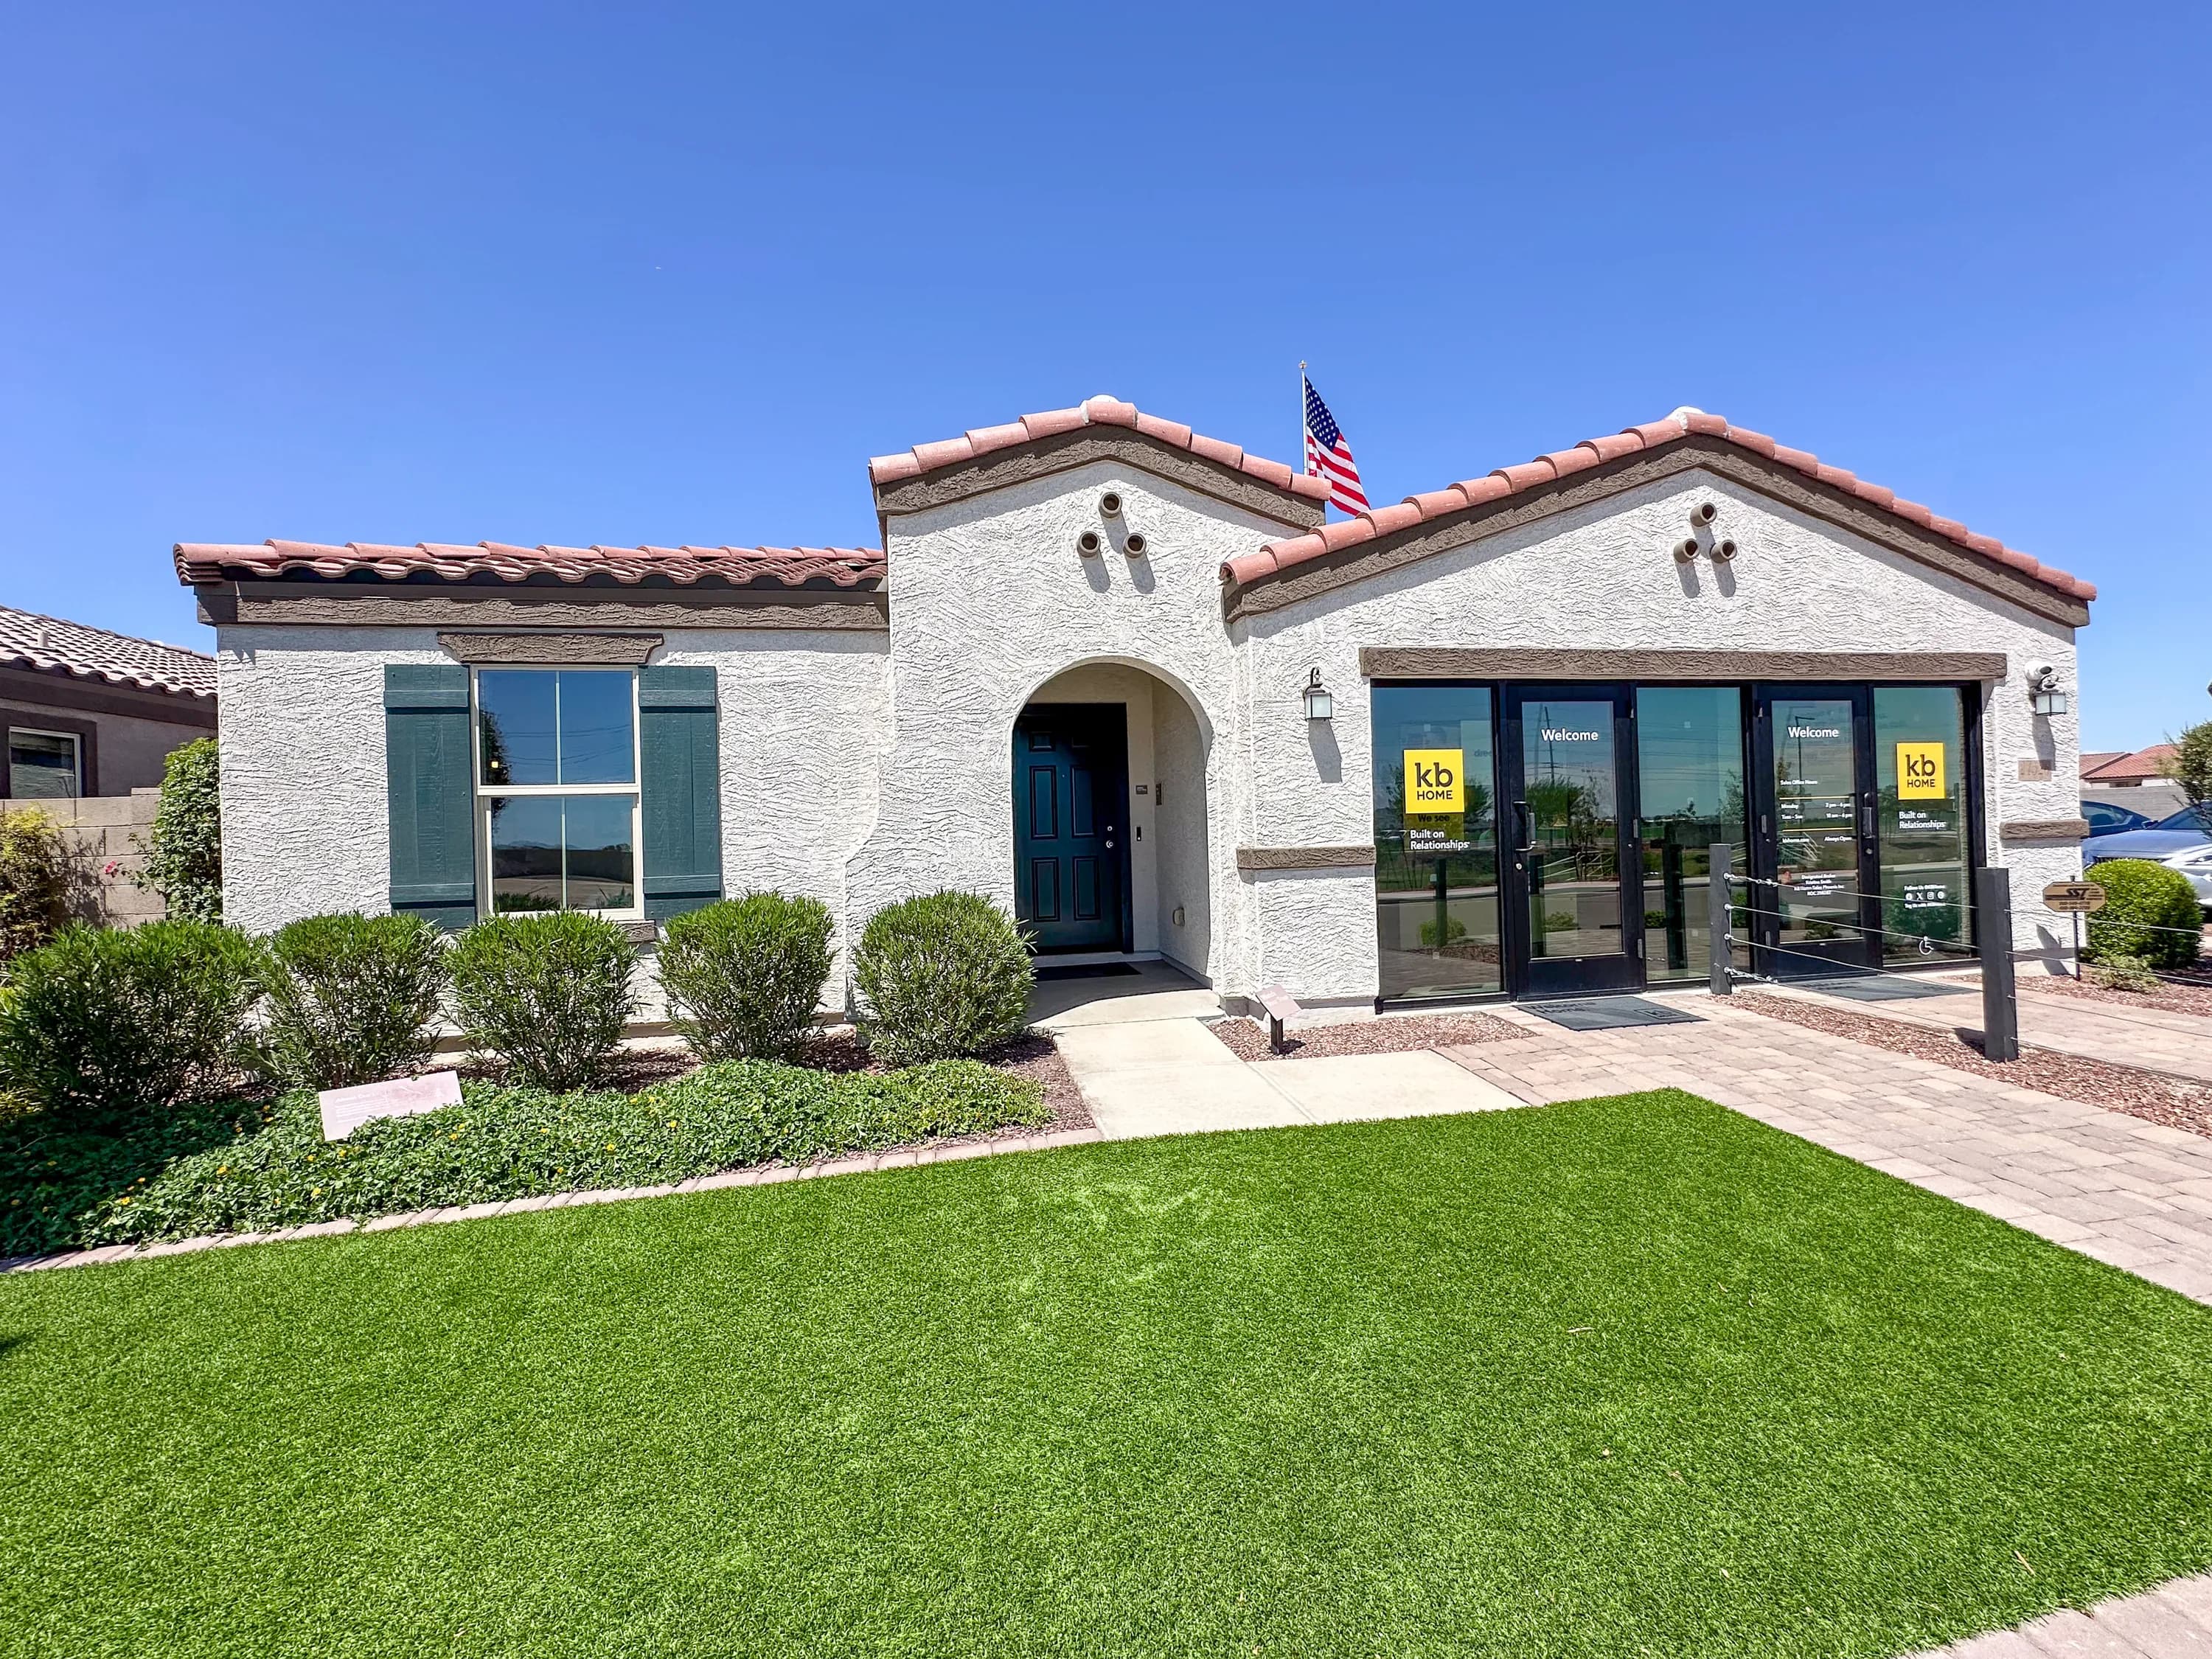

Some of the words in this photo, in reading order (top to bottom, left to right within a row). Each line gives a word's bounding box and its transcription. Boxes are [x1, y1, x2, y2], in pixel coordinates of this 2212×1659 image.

[1541, 728, 1599, 741] Welcome
[1787, 726, 1840, 738] Welcome
[1905, 754, 1935, 776] kb
[1415, 762, 1453, 787] kb
[1907, 779, 1935, 787] HOME
[1417, 790, 1453, 800] HOME
[1418, 814, 1432, 822] We
[1899, 810, 1916, 819] Built
[1899, 819, 1947, 830] Relationships
[1410, 830, 1431, 839] Built
[1433, 830, 1444, 838] on
[1411, 840, 1470, 851] Relationships
